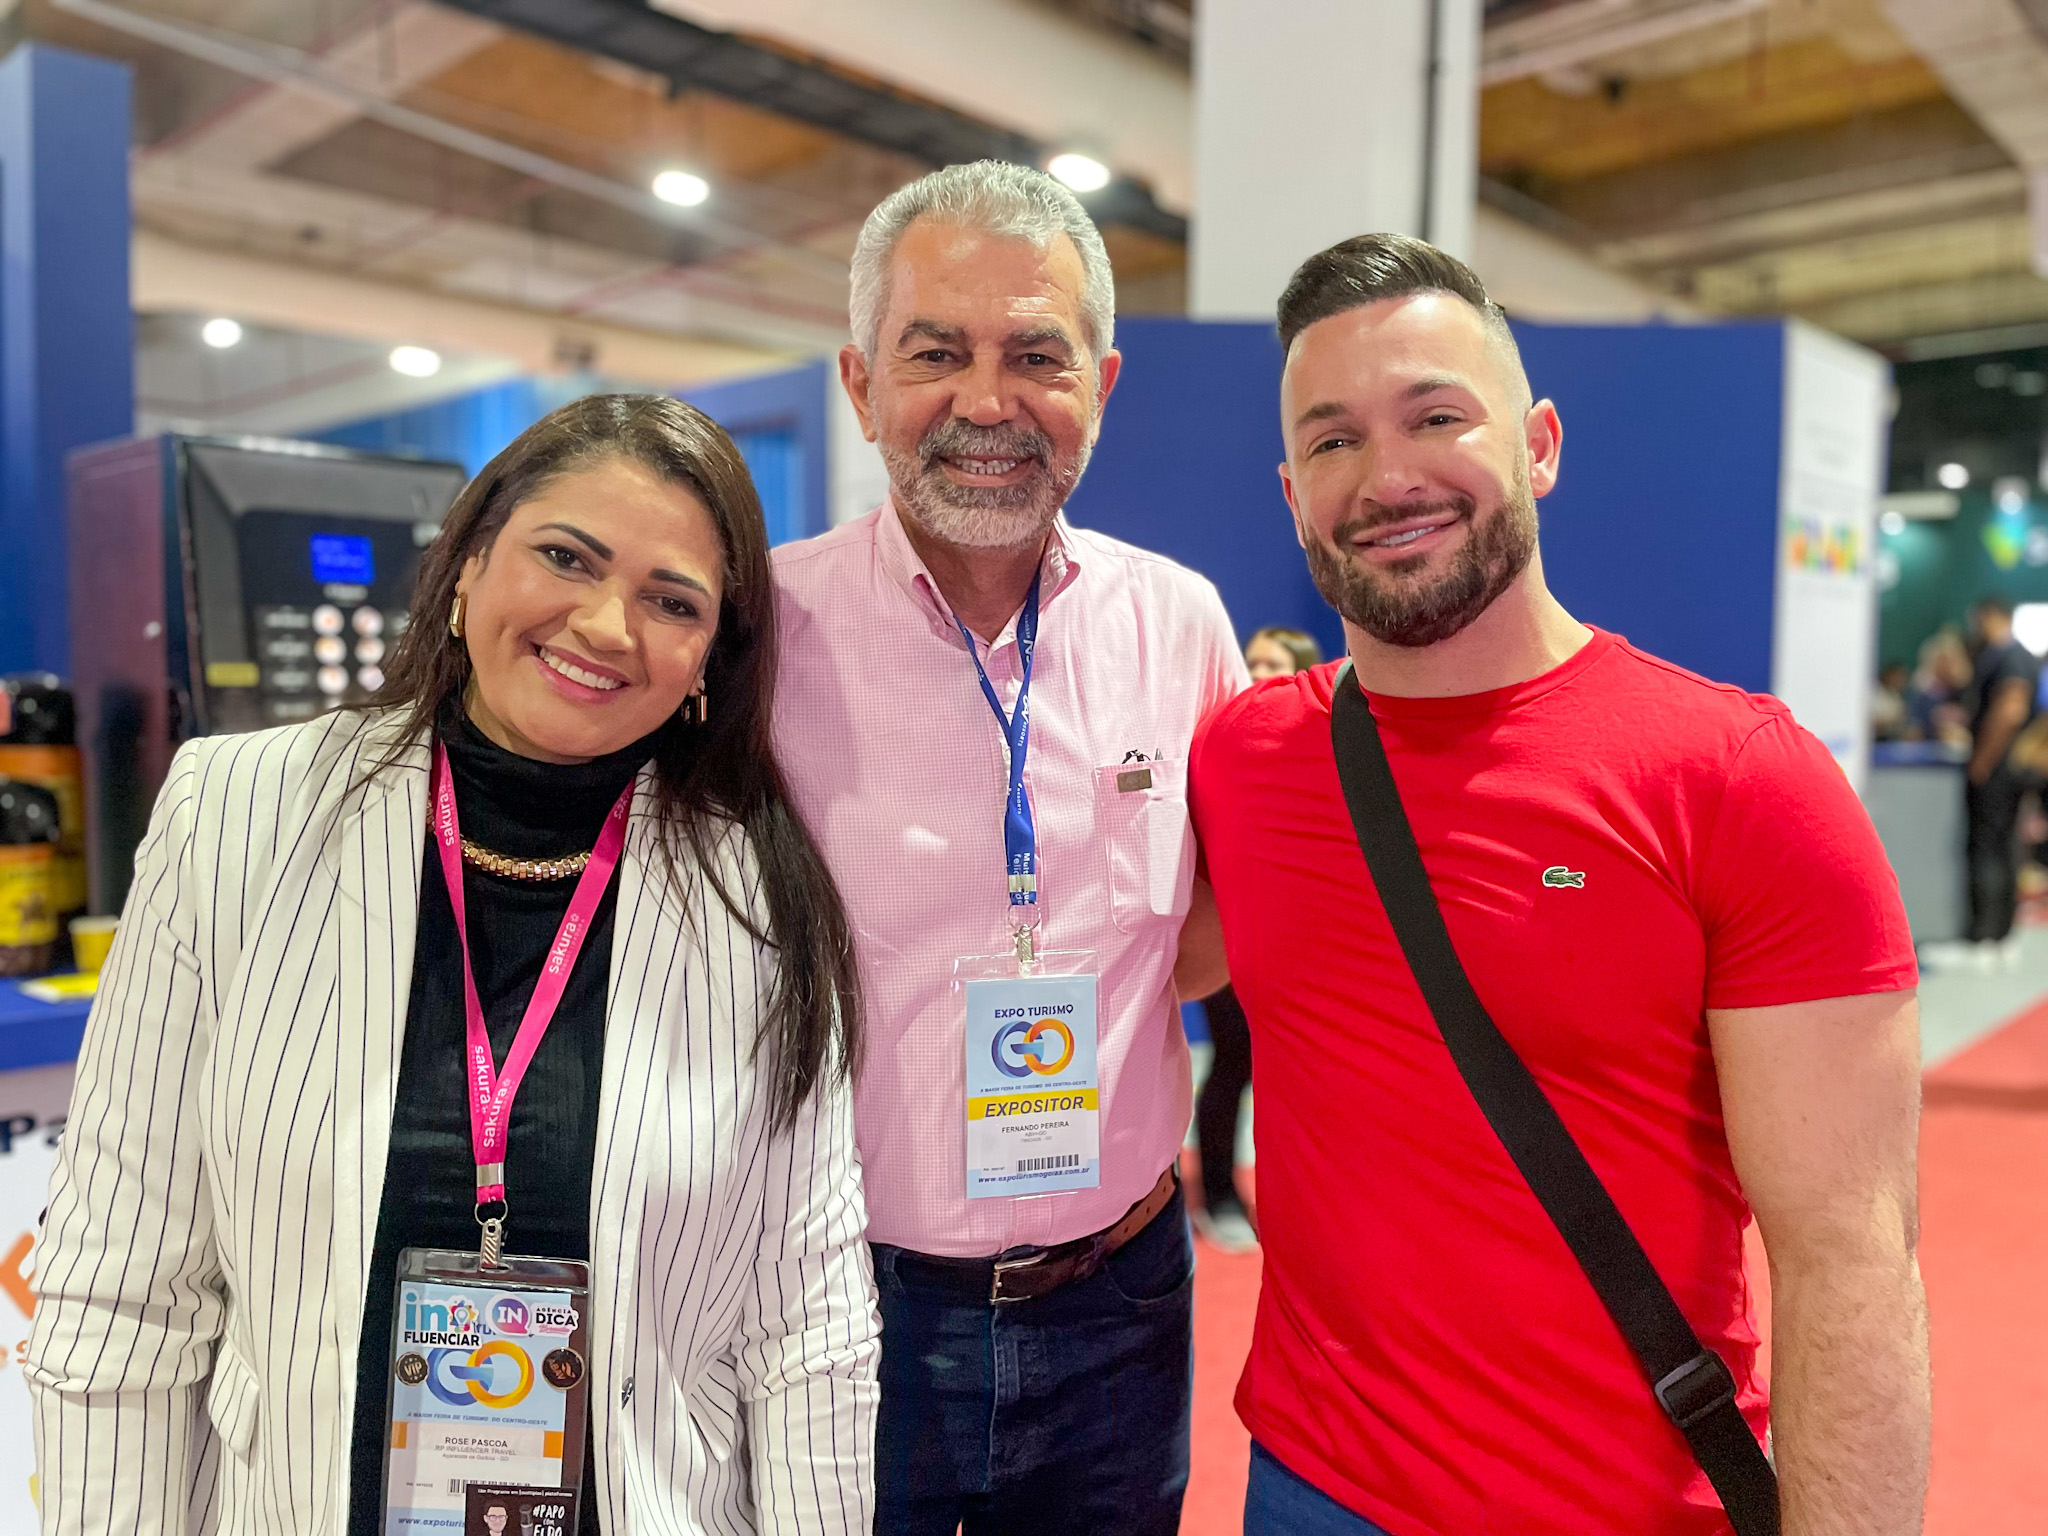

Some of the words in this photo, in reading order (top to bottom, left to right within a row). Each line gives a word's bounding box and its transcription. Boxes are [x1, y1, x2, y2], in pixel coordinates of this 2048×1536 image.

[440, 792, 454, 847] sakura
[548, 922, 577, 974] sakura
[994, 1008, 1025, 1018] EXPO
[1028, 1004, 1074, 1016] TURISMO
[475, 1045, 491, 1105] sakura
[984, 1096, 1084, 1118] EXPOSITOR
[483, 1088, 508, 1148] sakura
[1001, 1124, 1039, 1134] FERNANDO
[1040, 1121, 1070, 1130] PEREIRA
[406, 1292, 450, 1331] in
[497, 1306, 523, 1324] IN
[535, 1313, 576, 1327] DICA
[404, 1331, 480, 1347] FLUENCIAR
[404, 1362, 422, 1377] VIP
[502, 1417, 548, 1425] CENTRO-OESTE
[445, 1437, 469, 1445] ROSE
[471, 1438, 508, 1448] PASCOA
[491, 1447, 517, 1456] TRAVEL
[533, 1504, 565, 1520] #PAPO
